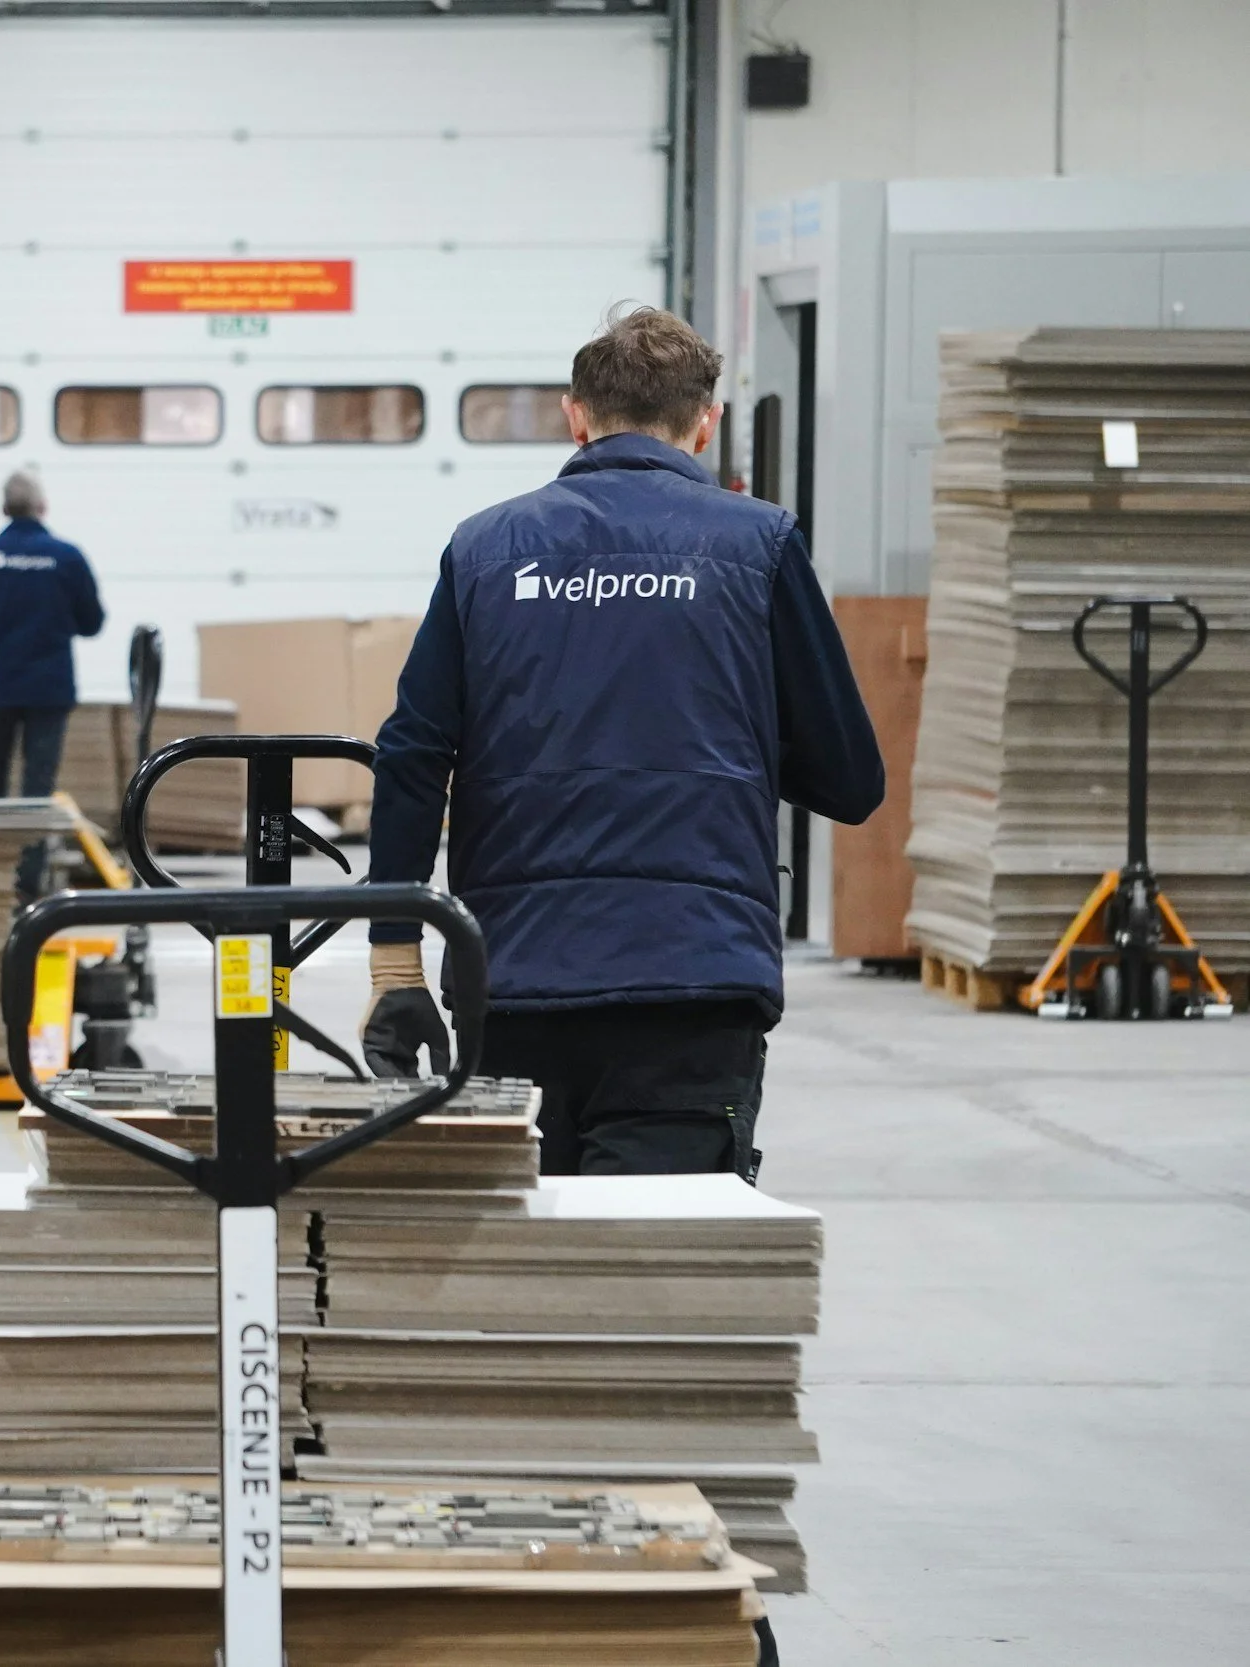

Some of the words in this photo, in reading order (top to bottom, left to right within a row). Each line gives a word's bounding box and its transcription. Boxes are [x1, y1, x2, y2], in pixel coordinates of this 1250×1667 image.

[544, 568, 696, 607] velprom
[241, 1324, 277, 1496] ČIŠĆENJE
[251, 1508, 257, 1518] -
[242, 1531, 270, 1576] P2
